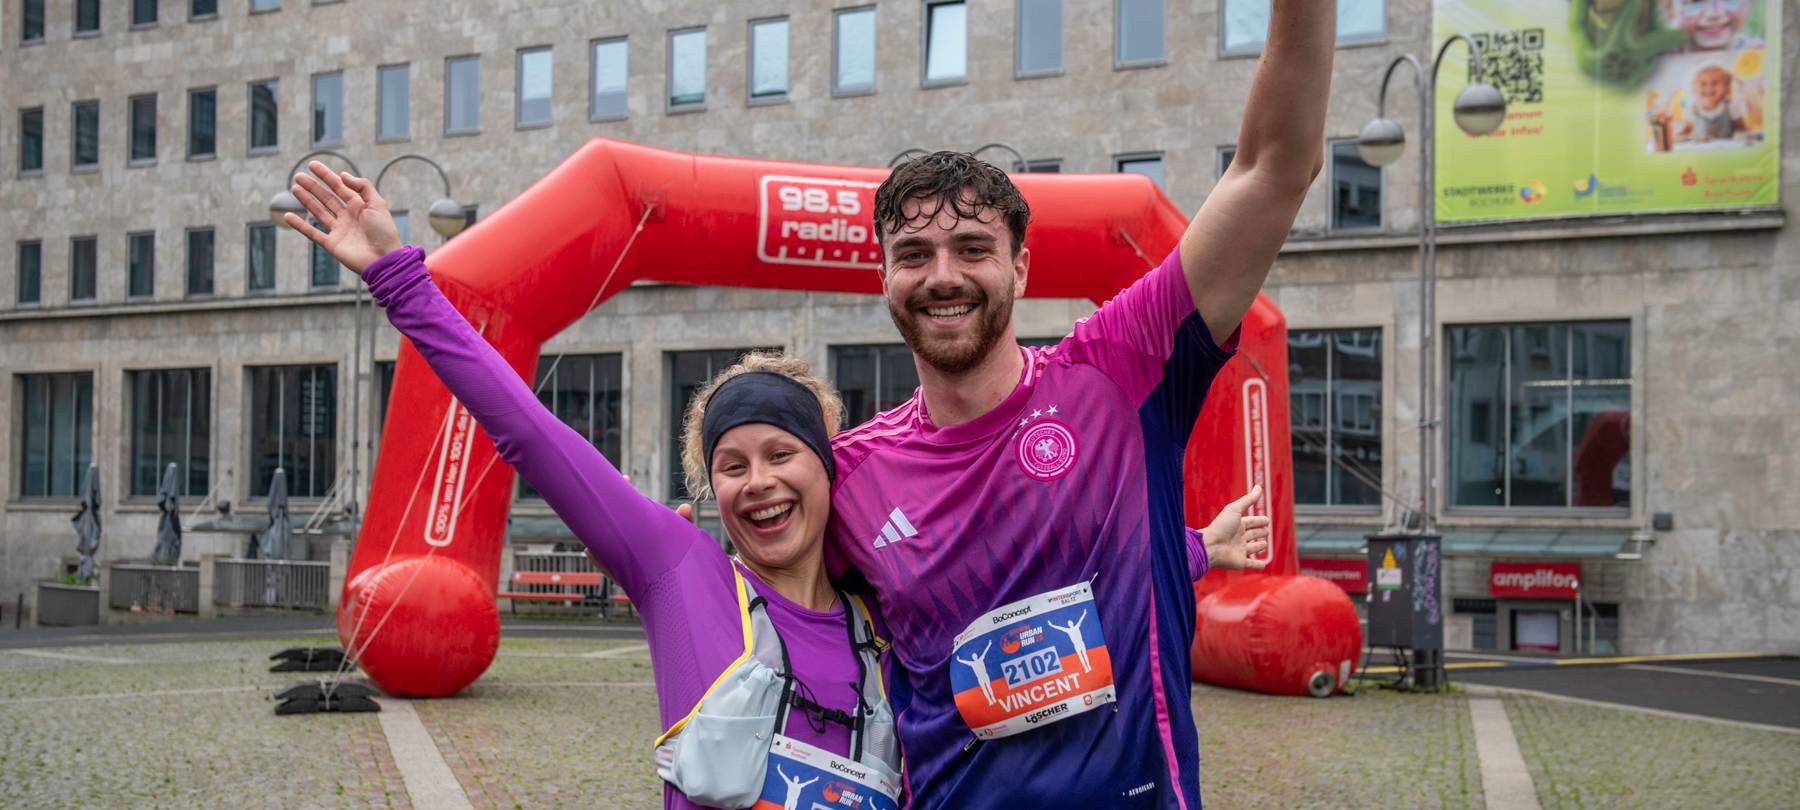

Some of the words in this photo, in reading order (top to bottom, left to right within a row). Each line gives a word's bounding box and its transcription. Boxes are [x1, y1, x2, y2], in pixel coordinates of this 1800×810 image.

[779, 186, 861, 215] 98.5
[781, 218, 867, 243] radio
[1493, 568, 1577, 591] amplifon
[992, 605, 1032, 624] BoConcept
[1019, 626, 1043, 640] URBAN
[1021, 636, 1036, 648] RUN
[1005, 651, 1059, 686] 2102
[998, 673, 1080, 713] VINCENT
[1025, 703, 1068, 724] LÖSCHER
[830, 760, 867, 780] BoConcept
